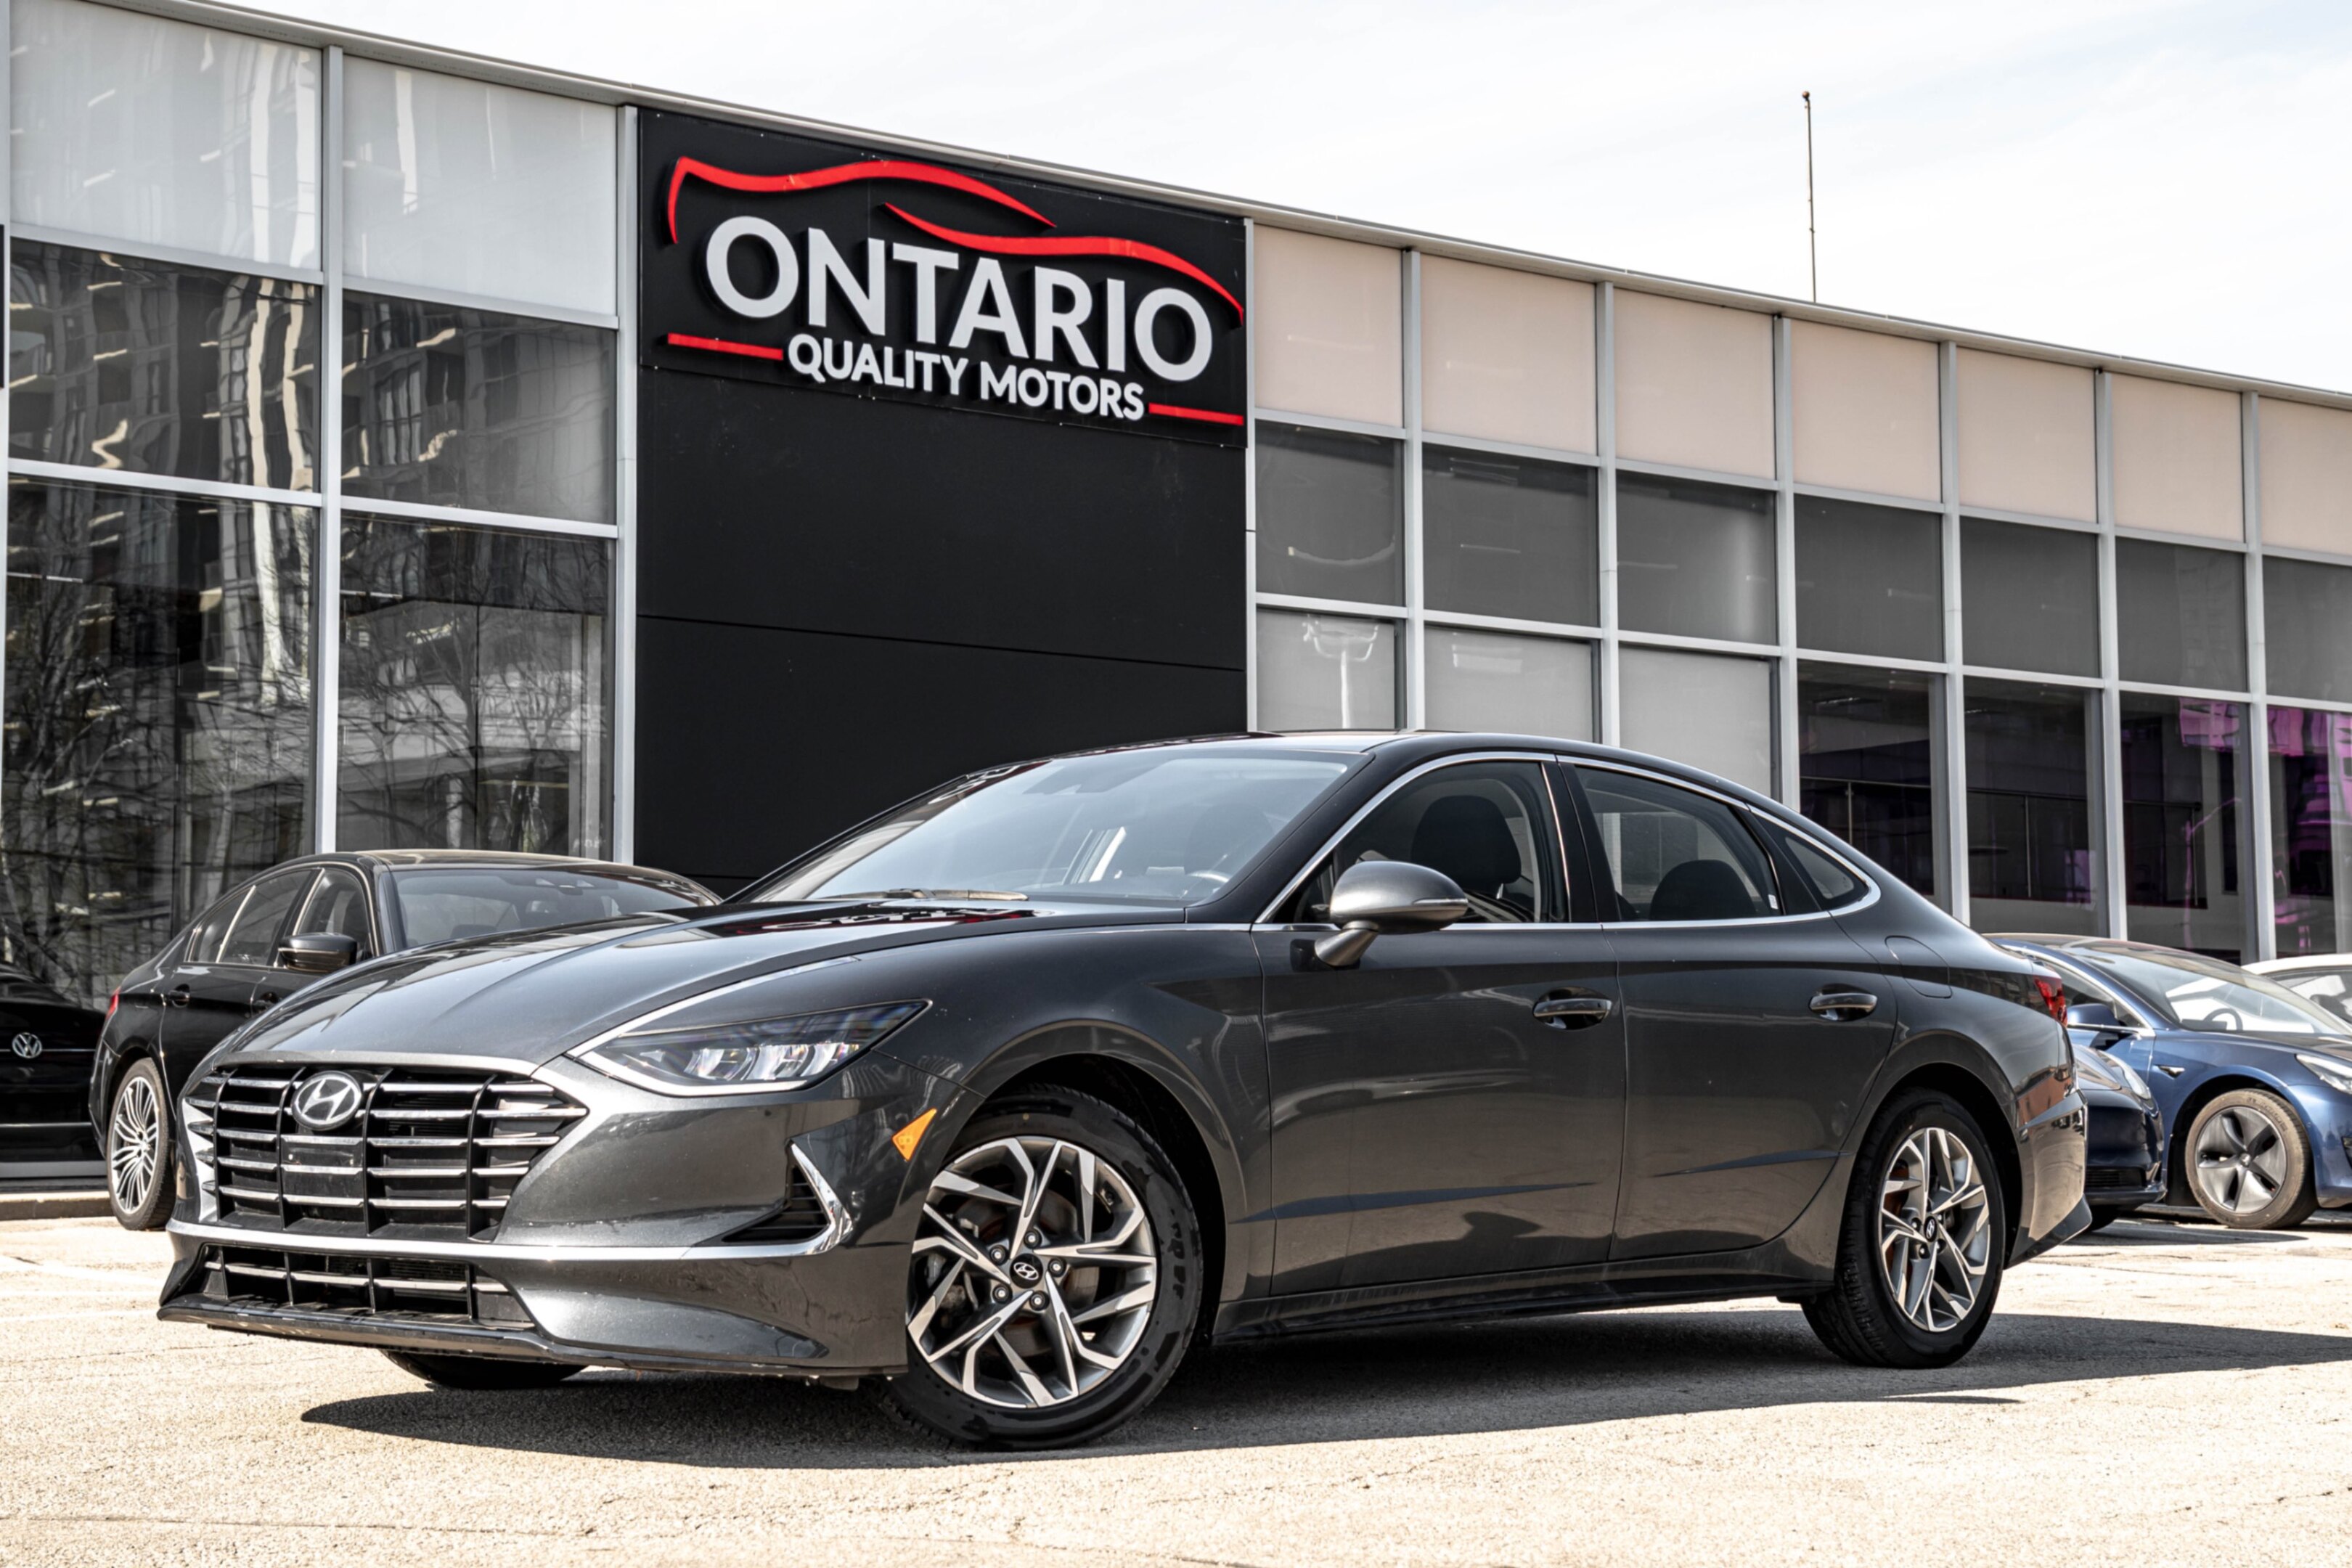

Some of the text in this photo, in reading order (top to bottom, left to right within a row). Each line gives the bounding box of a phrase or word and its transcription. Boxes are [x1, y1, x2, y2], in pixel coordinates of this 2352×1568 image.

[706, 216, 1212, 382] ONTARIO
[788, 333, 1145, 421] QUALITY MOTORS
